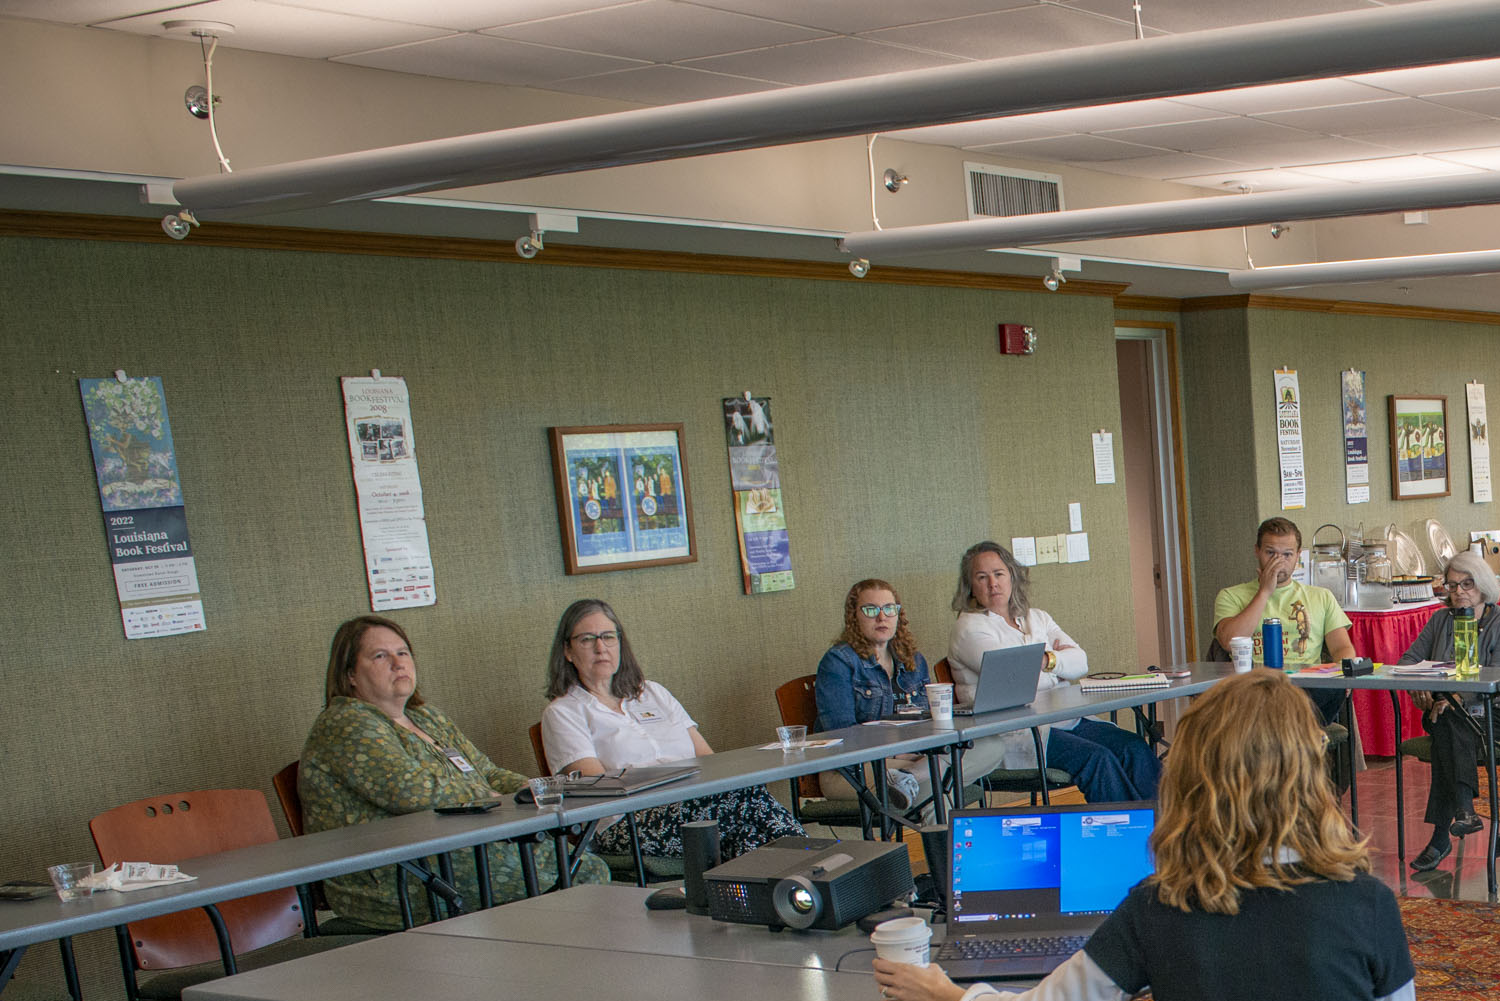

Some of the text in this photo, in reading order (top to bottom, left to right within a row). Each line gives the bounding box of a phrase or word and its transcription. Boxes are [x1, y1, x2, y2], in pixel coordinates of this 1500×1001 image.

[370, 404, 387, 413] 2008
[1280, 419, 1299, 428] BOOK
[110, 516, 134, 526] 2022
[113, 531, 168, 544] Louisiana
[116, 541, 188, 557] Book Festival
